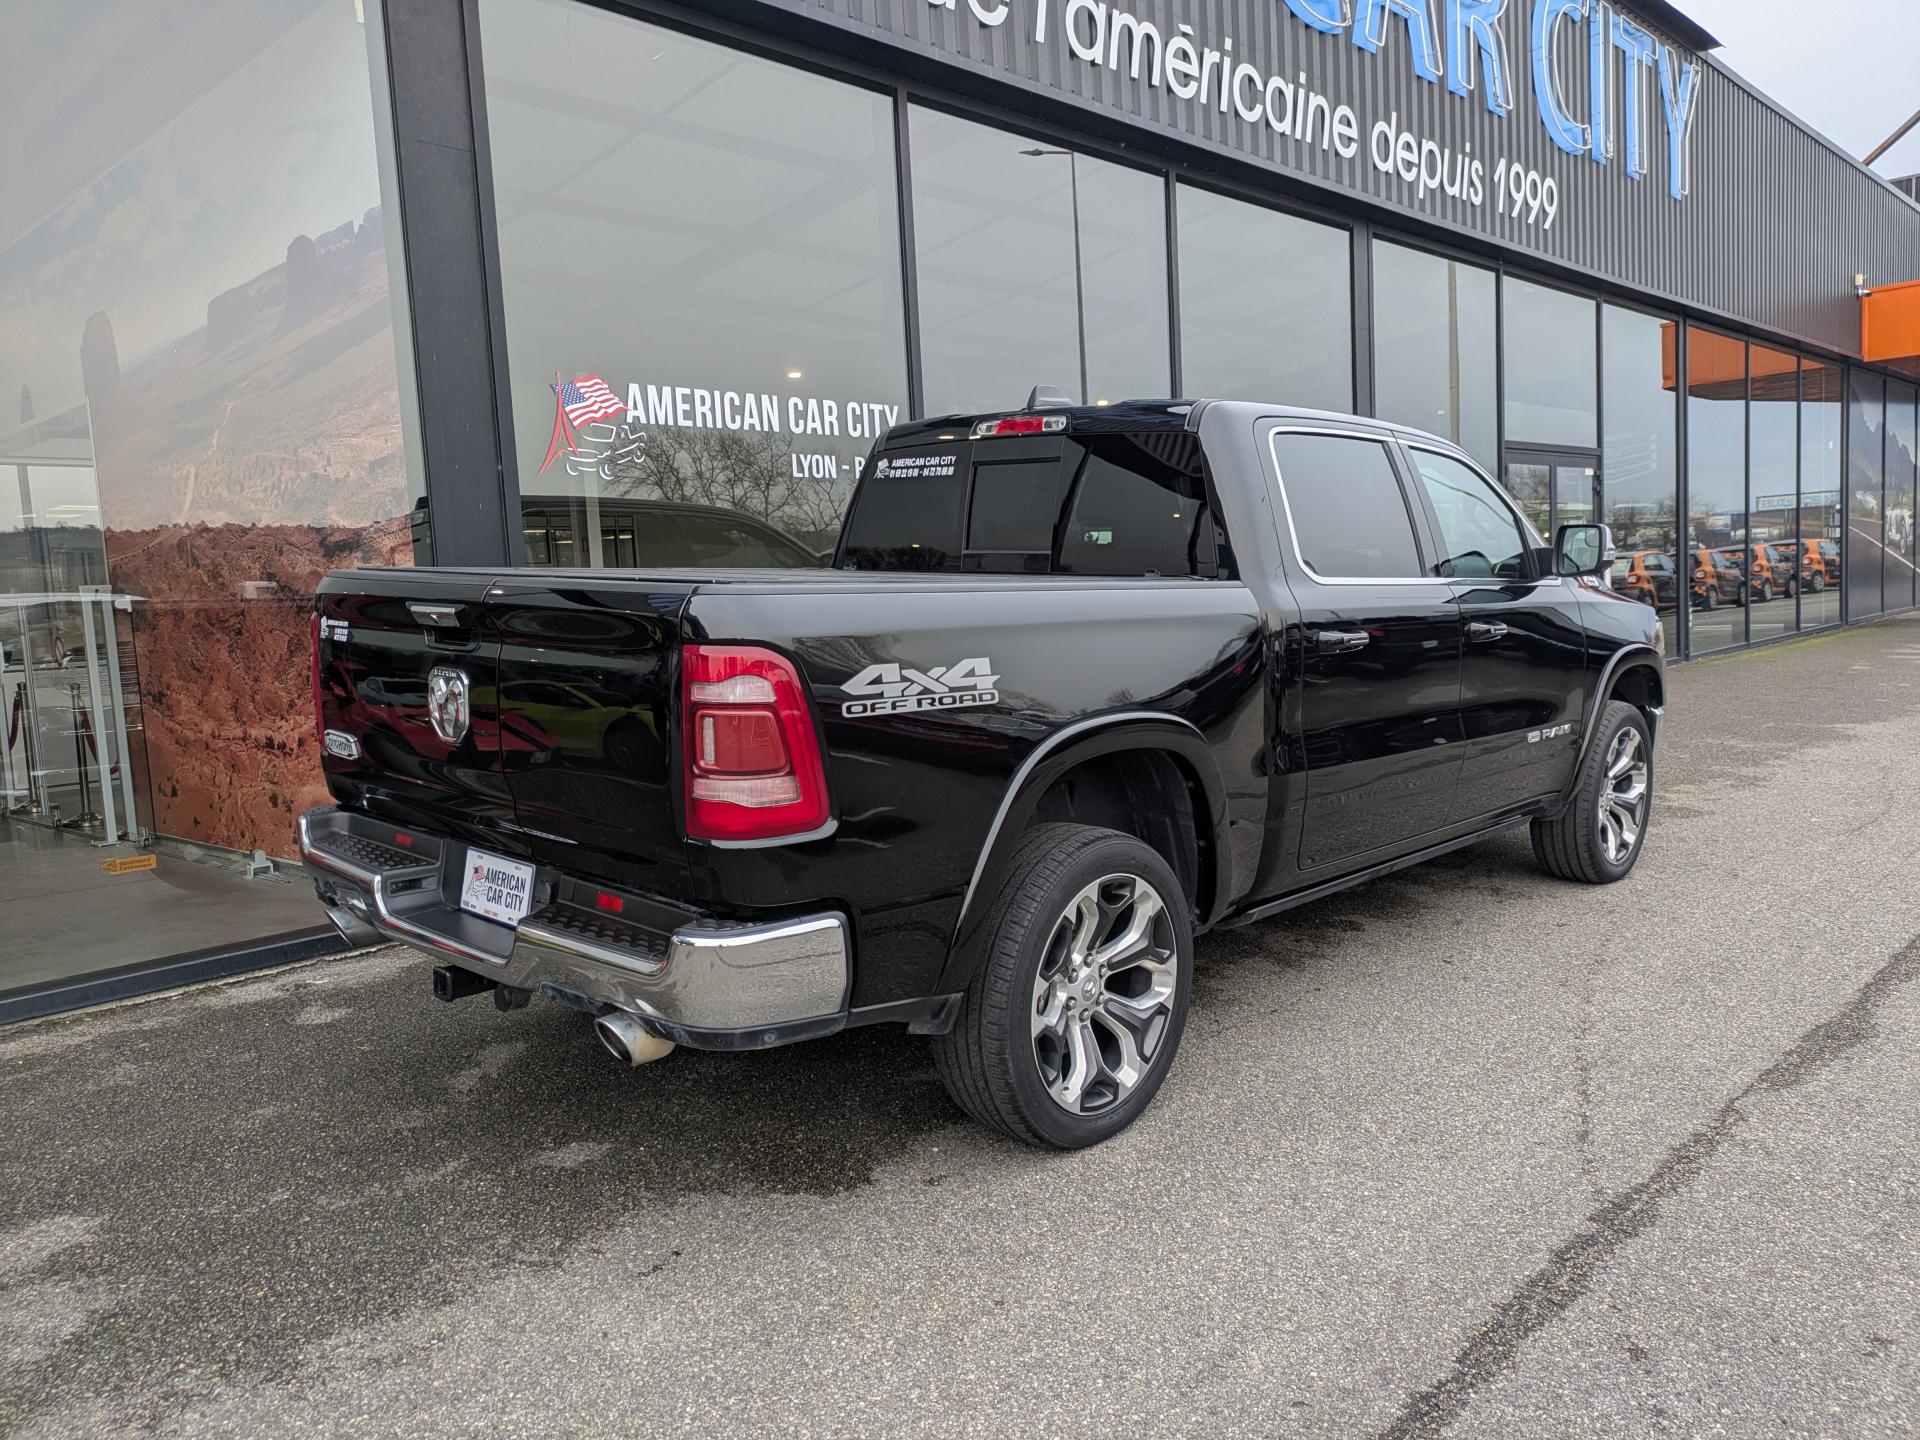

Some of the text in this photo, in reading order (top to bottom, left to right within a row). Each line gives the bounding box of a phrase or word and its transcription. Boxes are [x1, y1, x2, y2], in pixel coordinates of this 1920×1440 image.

[1532, 0, 1701, 200] CITY
[1371, 111, 1484, 206] depuis
[1493, 157, 1559, 230] 1999
[626, 383, 899, 438] AMERICAN CAR CITY
[791, 453, 837, 479] LYON
[891, 455, 956, 467] AMERICAN CAR CITY
[845, 691, 997, 715] OFF ROAD
[484, 867, 527, 895] AMERICAN
[486, 886, 504, 906] CAR
[504, 891, 524, 912] CITY
